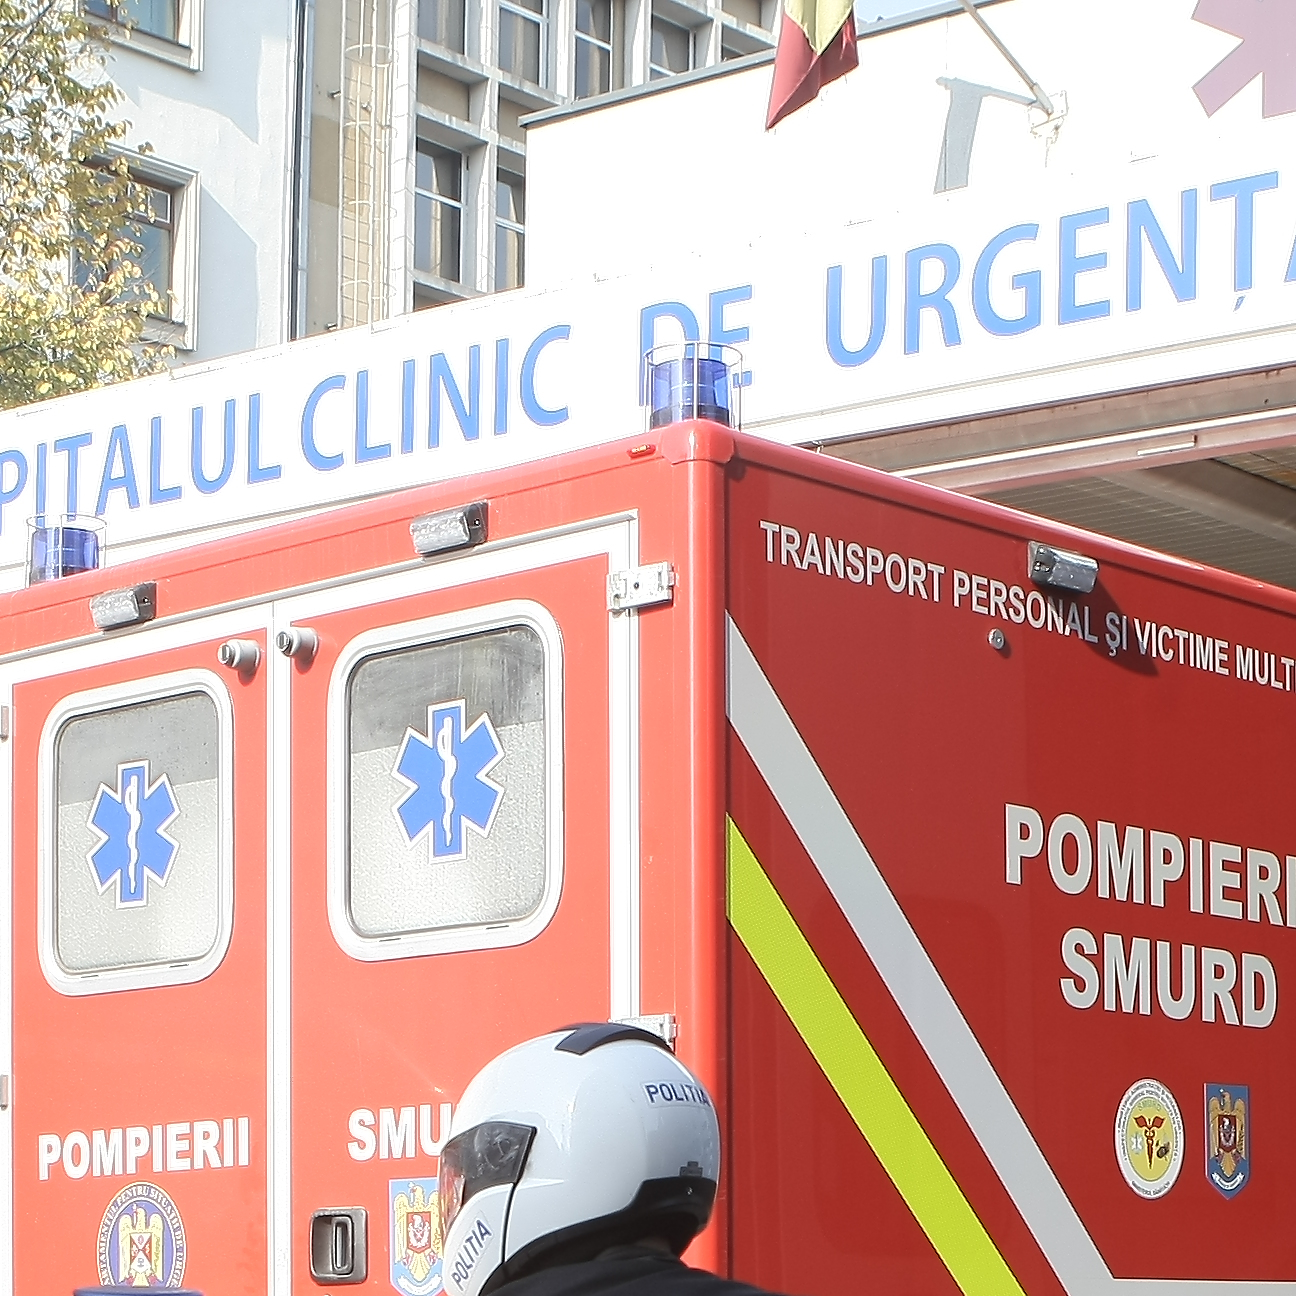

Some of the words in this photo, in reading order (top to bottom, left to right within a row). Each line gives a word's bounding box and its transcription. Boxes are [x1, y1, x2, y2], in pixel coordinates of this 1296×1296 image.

[302, 325, 572, 471] CLINIC
[639, 285, 752, 408] DE
[759, 520, 945, 602] TRANSPORT
[953, 569, 1098, 644] PERSONAL
[1134, 617, 1230, 676] VICTIME
[1060, 927, 1279, 1029] SMURD
[645, 1083, 711, 1107] POLITIA
[38, 1116, 250, 1181] POMPIERII
[347, 1102, 452, 1162] SMU
[451, 1219, 492, 1291] POLITIA
